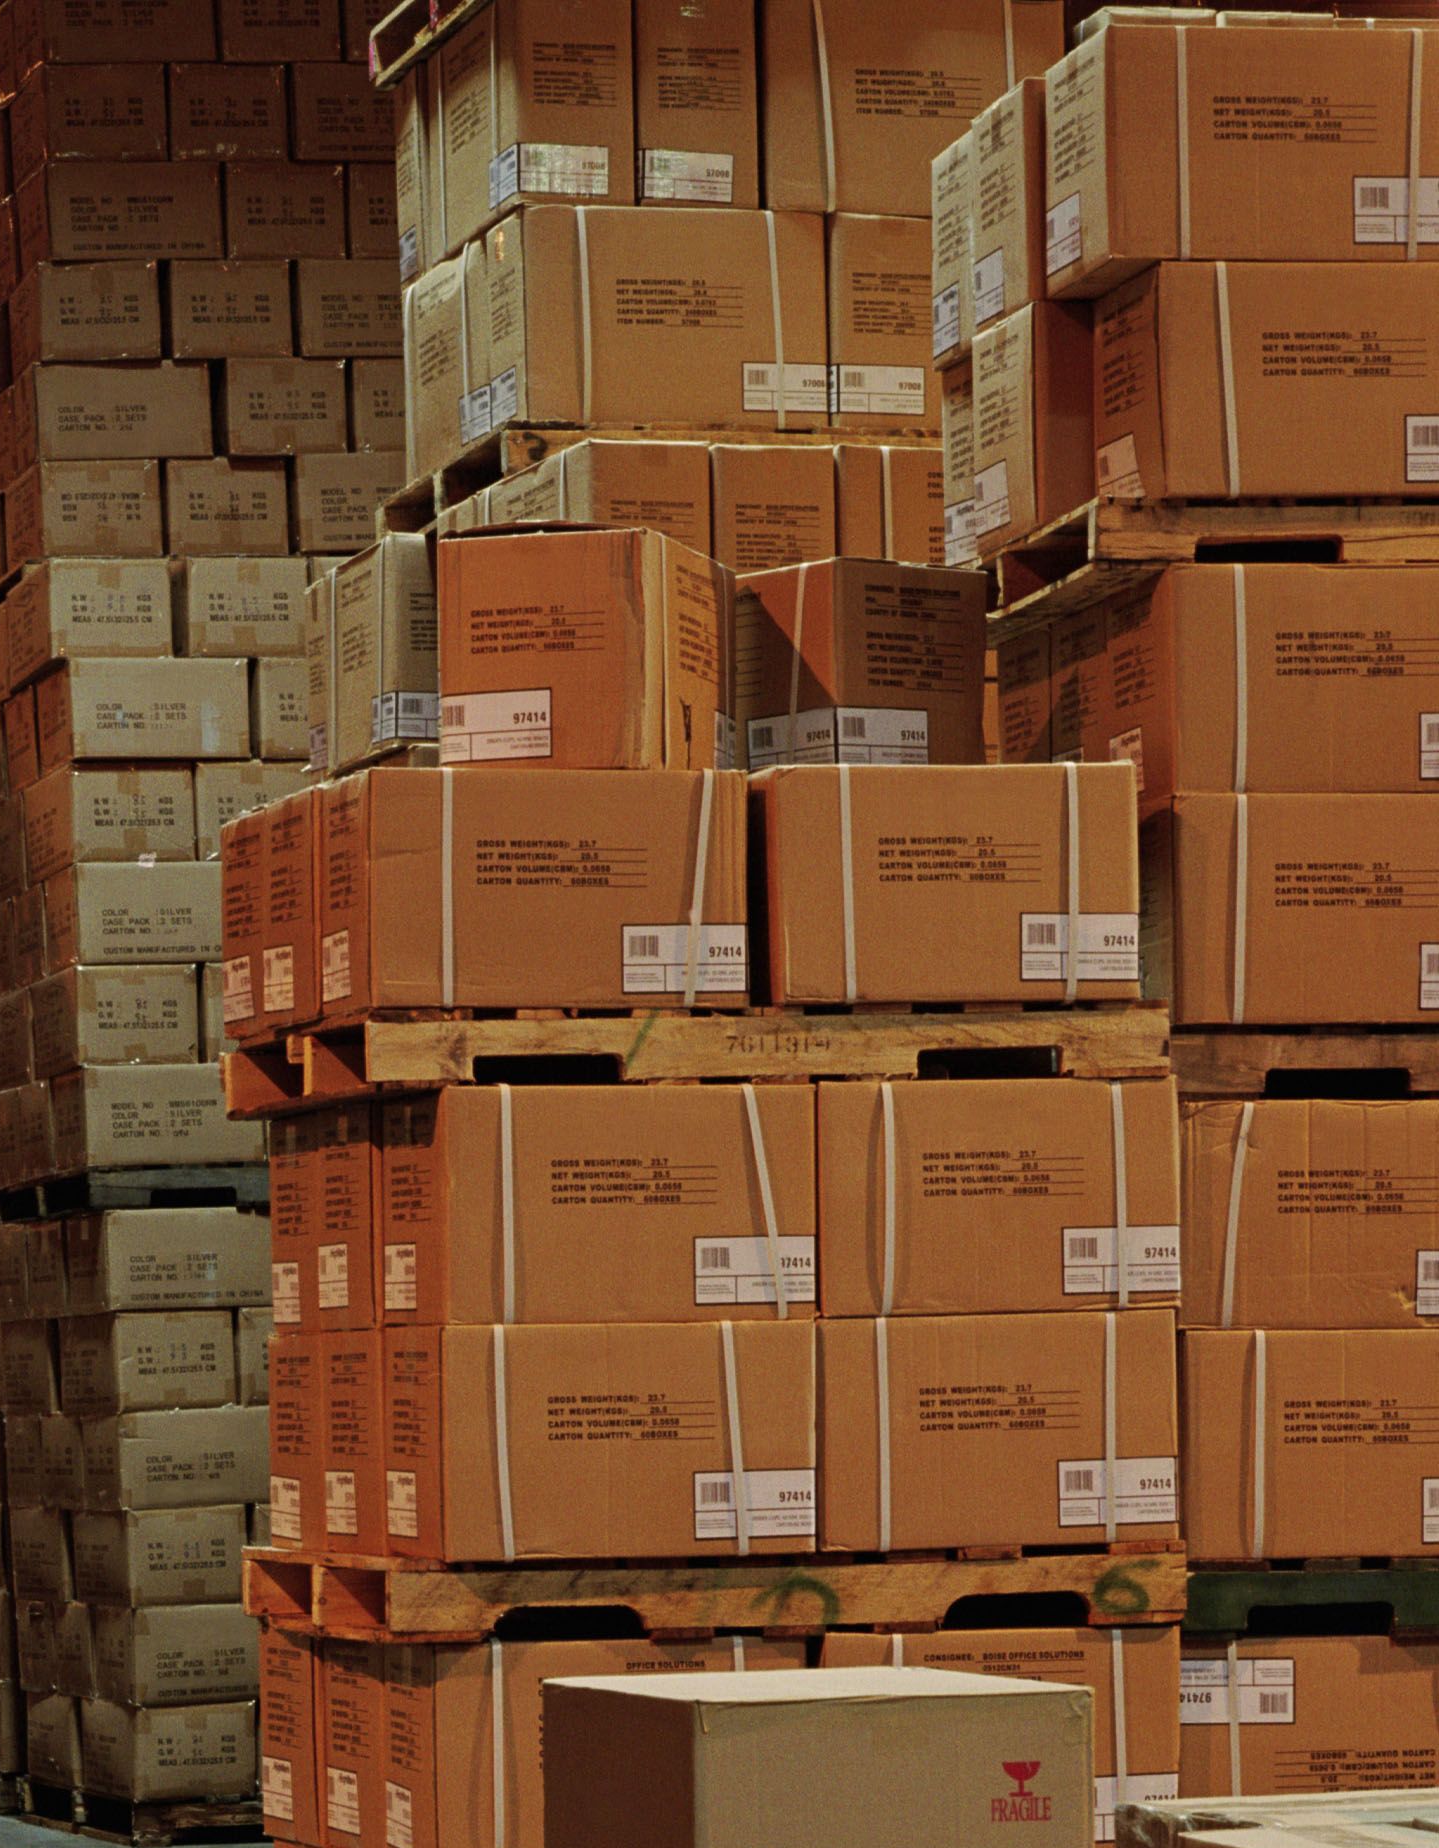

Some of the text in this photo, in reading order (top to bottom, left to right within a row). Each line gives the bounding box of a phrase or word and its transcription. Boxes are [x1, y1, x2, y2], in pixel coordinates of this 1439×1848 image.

[513, 711, 546, 724] 97414
[807, 730, 830, 742] 97414
[901, 730, 925, 741] 97414
[477, 840, 505, 848] GROSS
[878, 837, 906, 845] GROSS
[879, 849, 895, 857] NET
[477, 865, 512, 873] CARTON
[879, 861, 912, 869] CARTON
[477, 877, 512, 885] CARTON
[517, 877, 562, 885] QUANTITY:
[879, 873, 961, 882] CARTON QUANTITY:
[1104, 936, 1135, 946] 97414
[709, 946, 741, 957] 97414
[923, 1152, 950, 1160] GROSS
[551, 1160, 579, 1168] GROSS
[551, 1172, 568, 1180] NET
[923, 1176, 956, 1184] CARTON
[961, 1187, 1005, 1195] QUANTITY:
[552, 1196, 635, 1204] CARTON QUANTITY:
[1145, 1247, 1176, 1258] 97414
[919, 1387, 947, 1395] GROSS
[548, 1396, 576, 1404] GROSS
[920, 1399, 936, 1407] NET
[920, 1411, 954, 1419] CARTON
[548, 1420, 582, 1428] CARTON
[920, 1421, 1001, 1431] CARTON QUANTITY:
[548, 1432, 582, 1440] CARTON
[587, 1431, 632, 1439] QUANTITY:
[1140, 1479, 1171, 1489] 97414
[779, 1491, 811, 1502] 97414
[1009, 1652, 1036, 1660] OFFICE
[1039, 1651, 1084, 1660] SOLUTIONS
[626, 1660, 705, 1670] OFFICE SOLUTIONS
[991, 1797, 1052, 1822] FRAGILE
